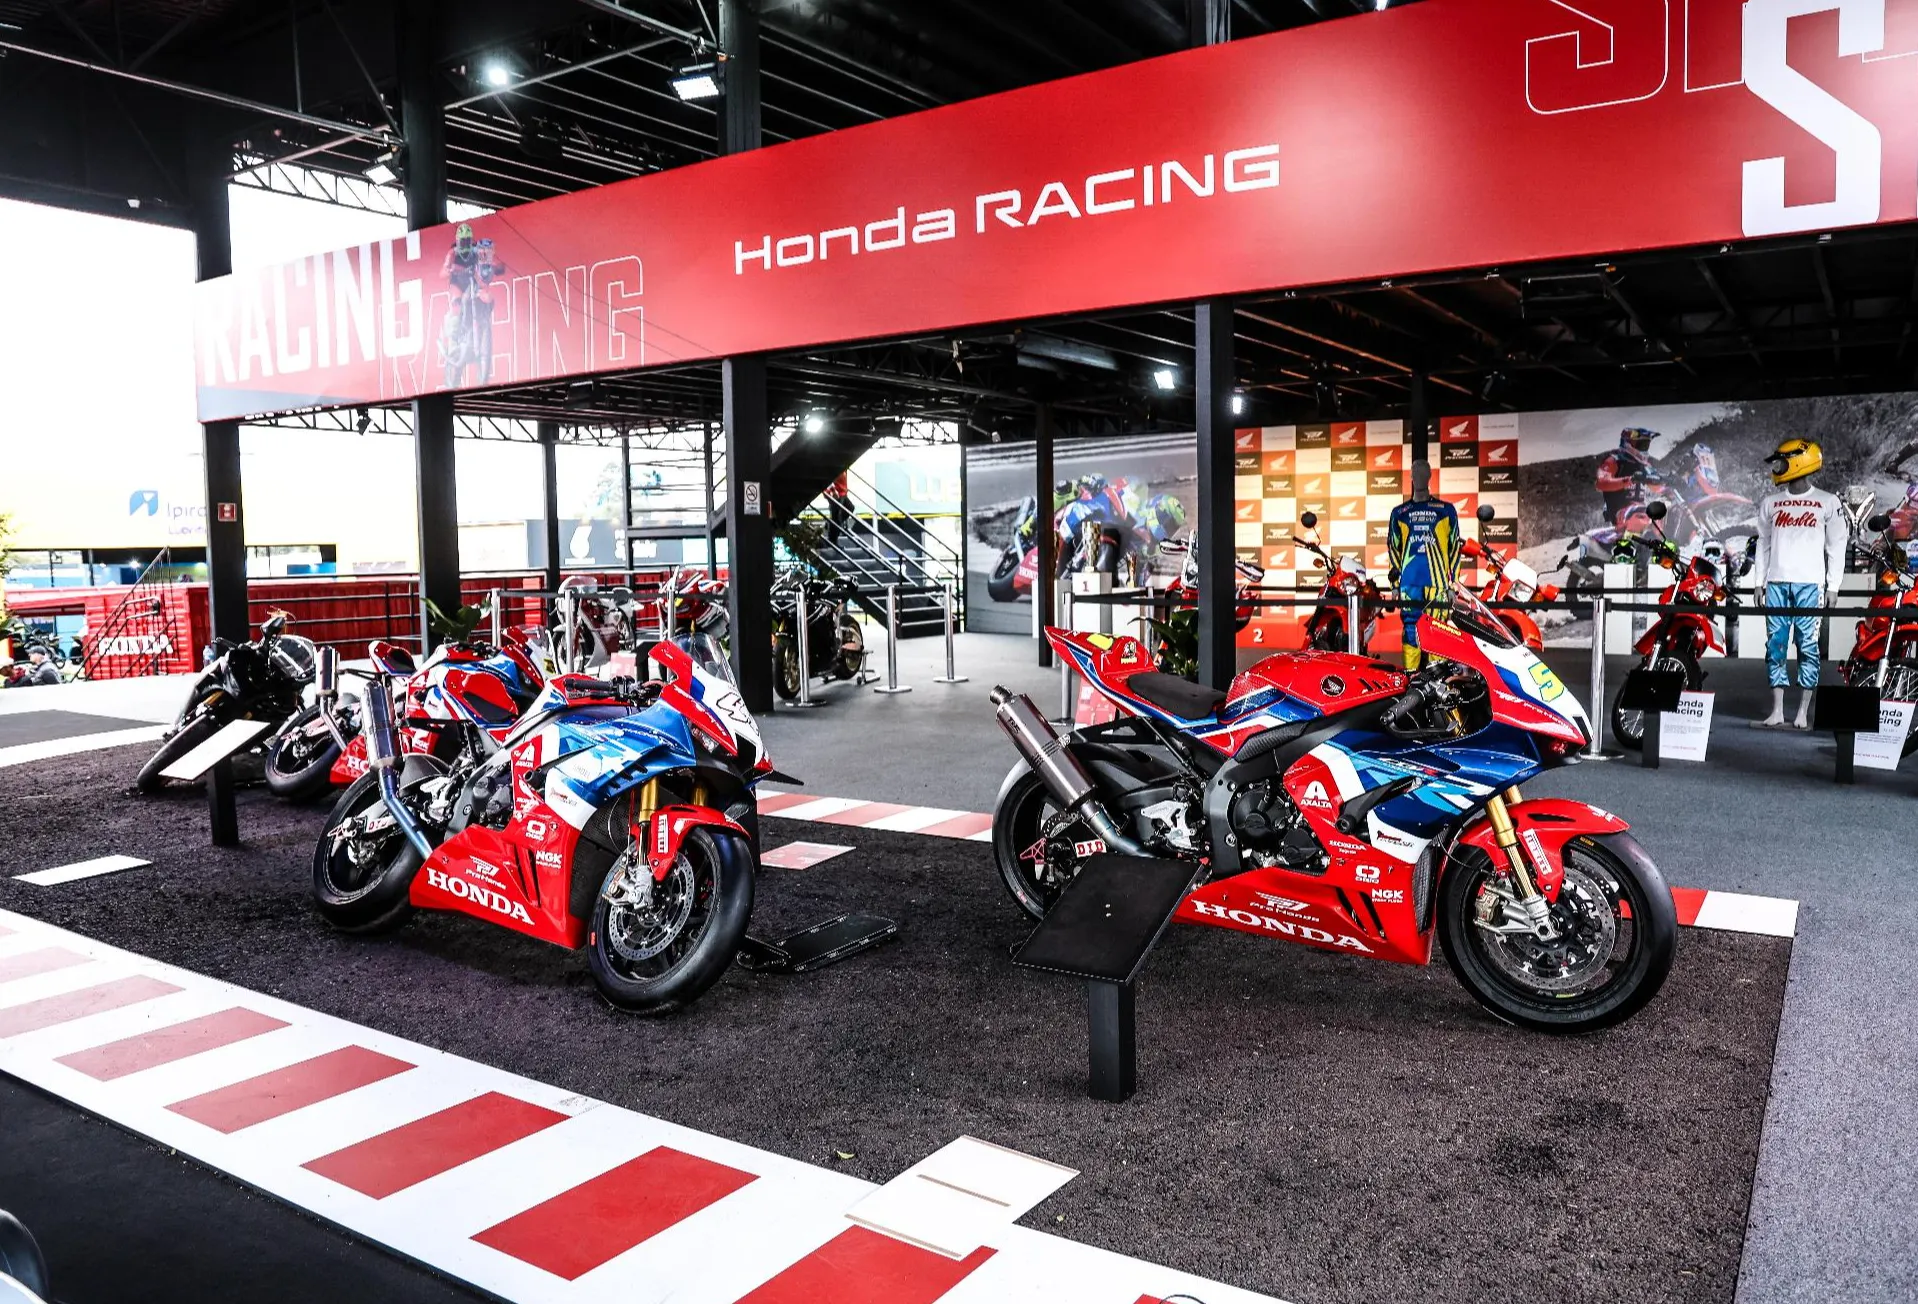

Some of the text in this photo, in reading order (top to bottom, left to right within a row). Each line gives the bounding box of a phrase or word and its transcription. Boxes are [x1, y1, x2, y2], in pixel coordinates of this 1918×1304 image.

[734, 143, 1280, 275] Honda RACING
[203, 231, 424, 387] RACING
[1773, 499, 1822, 509] HONDA
[1772, 509, 1818, 528] Mesbla
[1082, 580, 1090, 593] 1
[1252, 627, 1263, 643] 2
[1678, 699, 1704, 708] onda
[1879, 709, 1903, 718] nda
[1878, 716, 1902, 728] cing
[1300, 799, 1333, 809] AXALTA
[1329, 839, 1367, 851] HONDA
[535, 850, 563, 865] NGK
[426, 867, 536, 926] HONDA
[1371, 888, 1404, 899] NGK
[1191, 899, 1375, 954] HONDA
